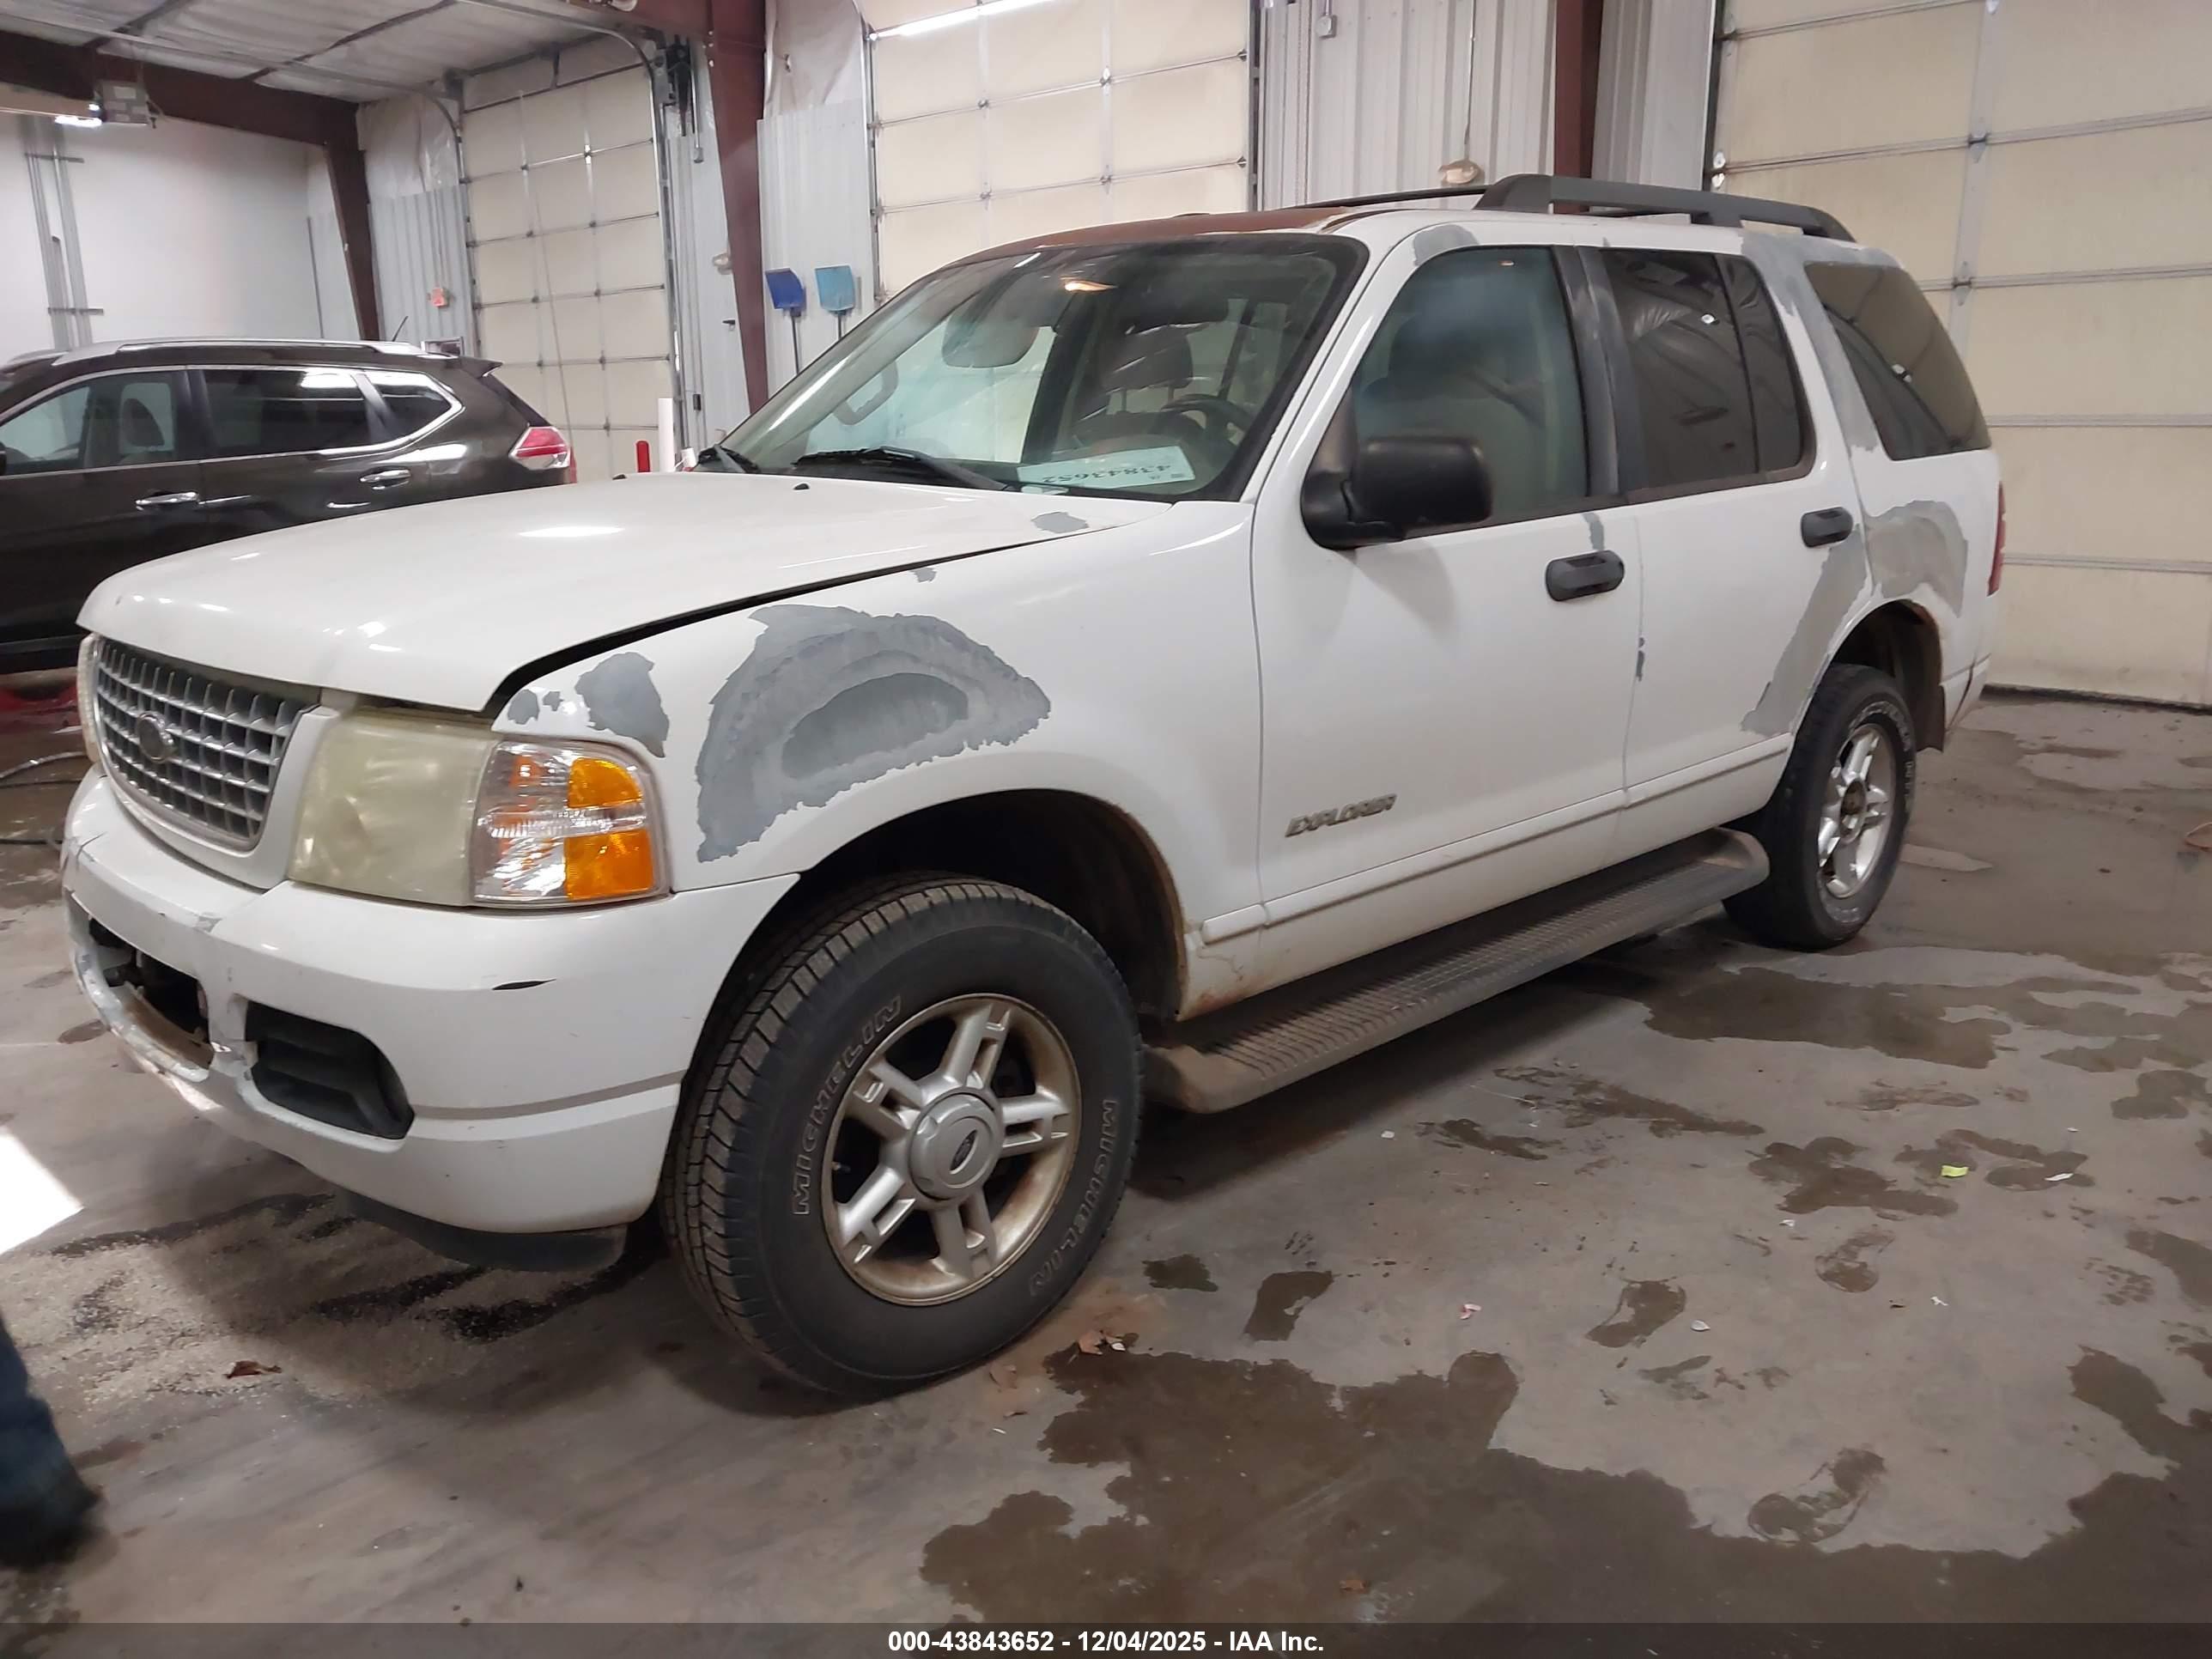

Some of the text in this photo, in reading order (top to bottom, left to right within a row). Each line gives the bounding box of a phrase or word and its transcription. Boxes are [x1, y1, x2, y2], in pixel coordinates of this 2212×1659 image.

[1042, 465, 1170, 483] 43843652
[1285, 793, 1397, 837] EXPLORER
[792, 994, 902, 1216] MICHELIN
[1029, 1099, 1119, 1297] MICHELIN
